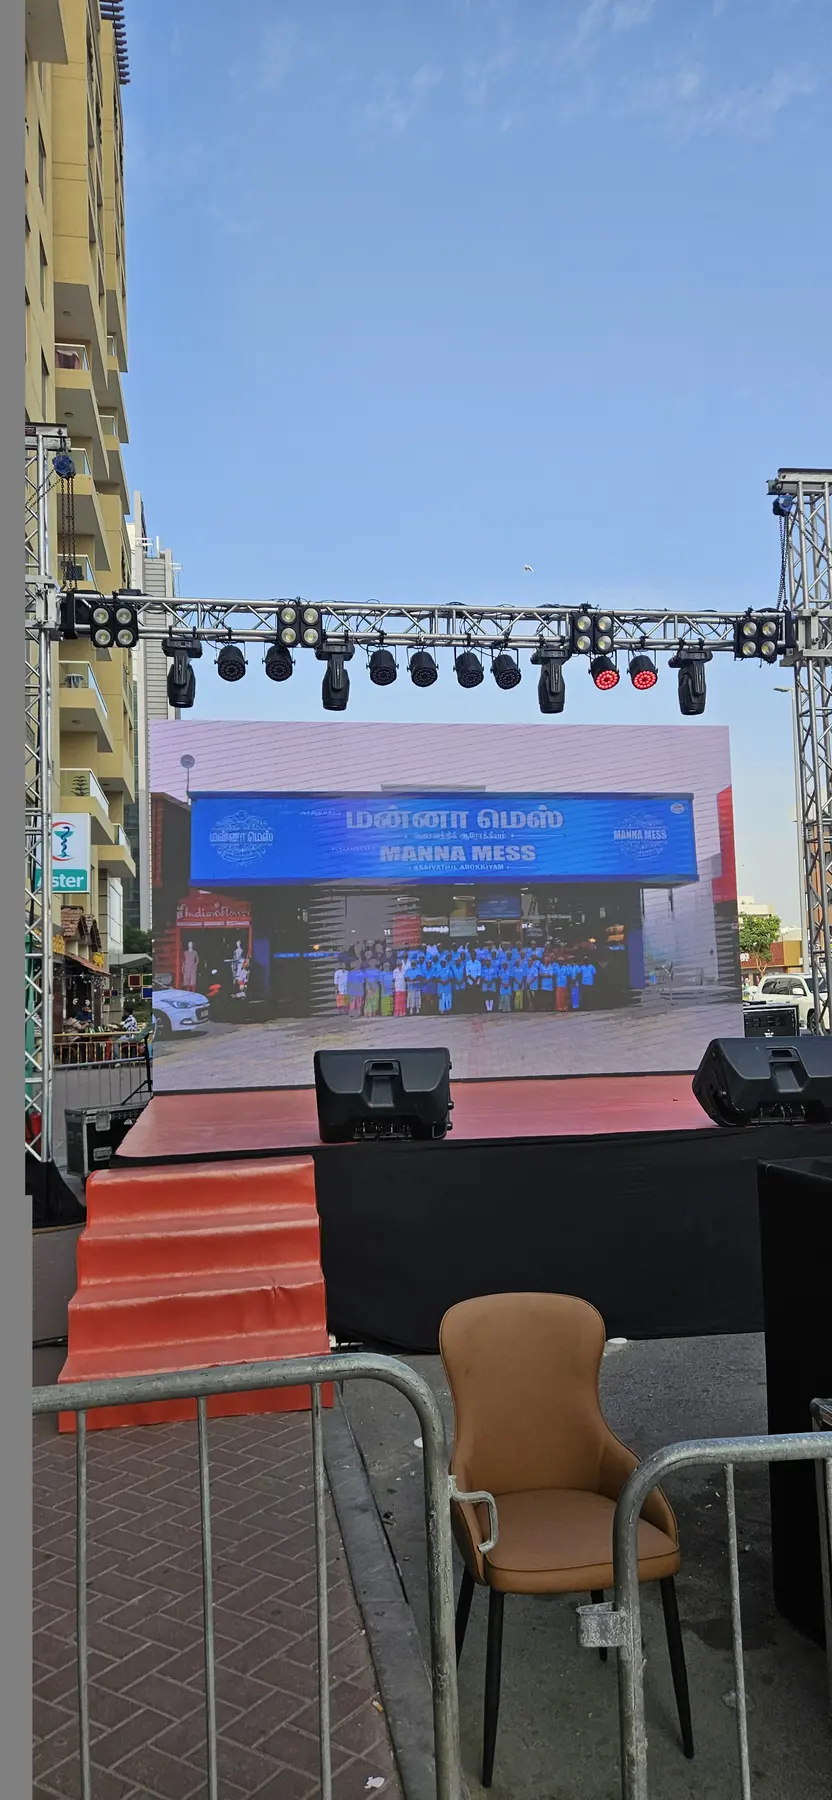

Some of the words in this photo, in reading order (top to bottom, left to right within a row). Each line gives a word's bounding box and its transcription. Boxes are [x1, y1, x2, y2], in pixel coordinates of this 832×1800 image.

[346, 804, 469, 829] மன்னா
[477, 804, 564, 829] மெஸ்
[210, 830, 246, 842] மன்னா
[248, 830, 274, 842] மெஸ்
[613, 829, 643, 840] MANNA
[644, 829, 667, 840] MESS
[381, 845, 466, 861] MANNA
[471, 845, 536, 861] MESS
